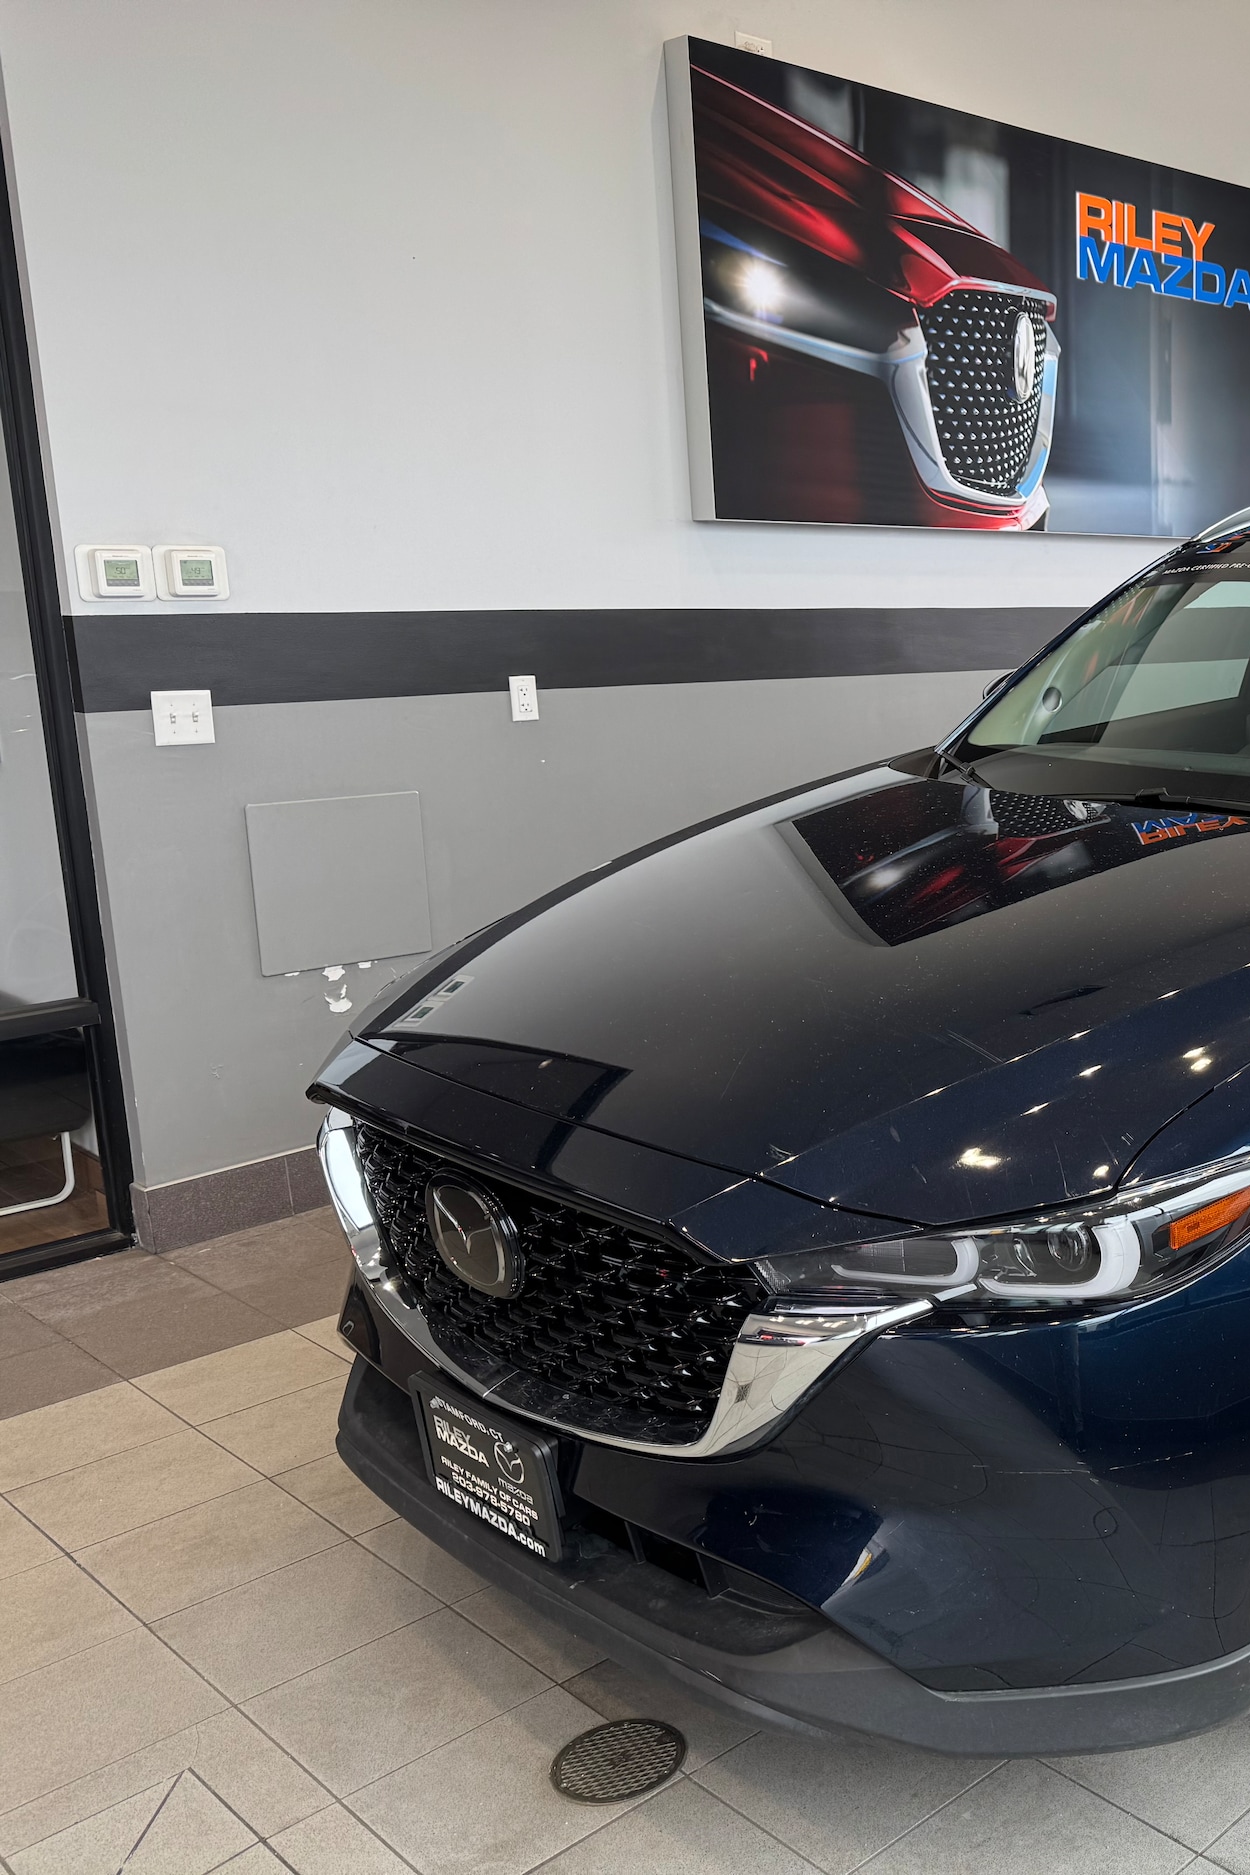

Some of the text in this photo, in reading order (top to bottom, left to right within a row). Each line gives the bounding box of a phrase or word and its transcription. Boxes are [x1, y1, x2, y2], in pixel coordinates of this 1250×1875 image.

[1076, 191, 1216, 262] RILEY
[433, 1415, 471, 1446] RILEY
[436, 1426, 490, 1468] MAZDA
[435, 1476, 546, 1557] RILEYMAZDA.com
[441, 1455, 539, 1520] RILEY FAMILY OF CARS
